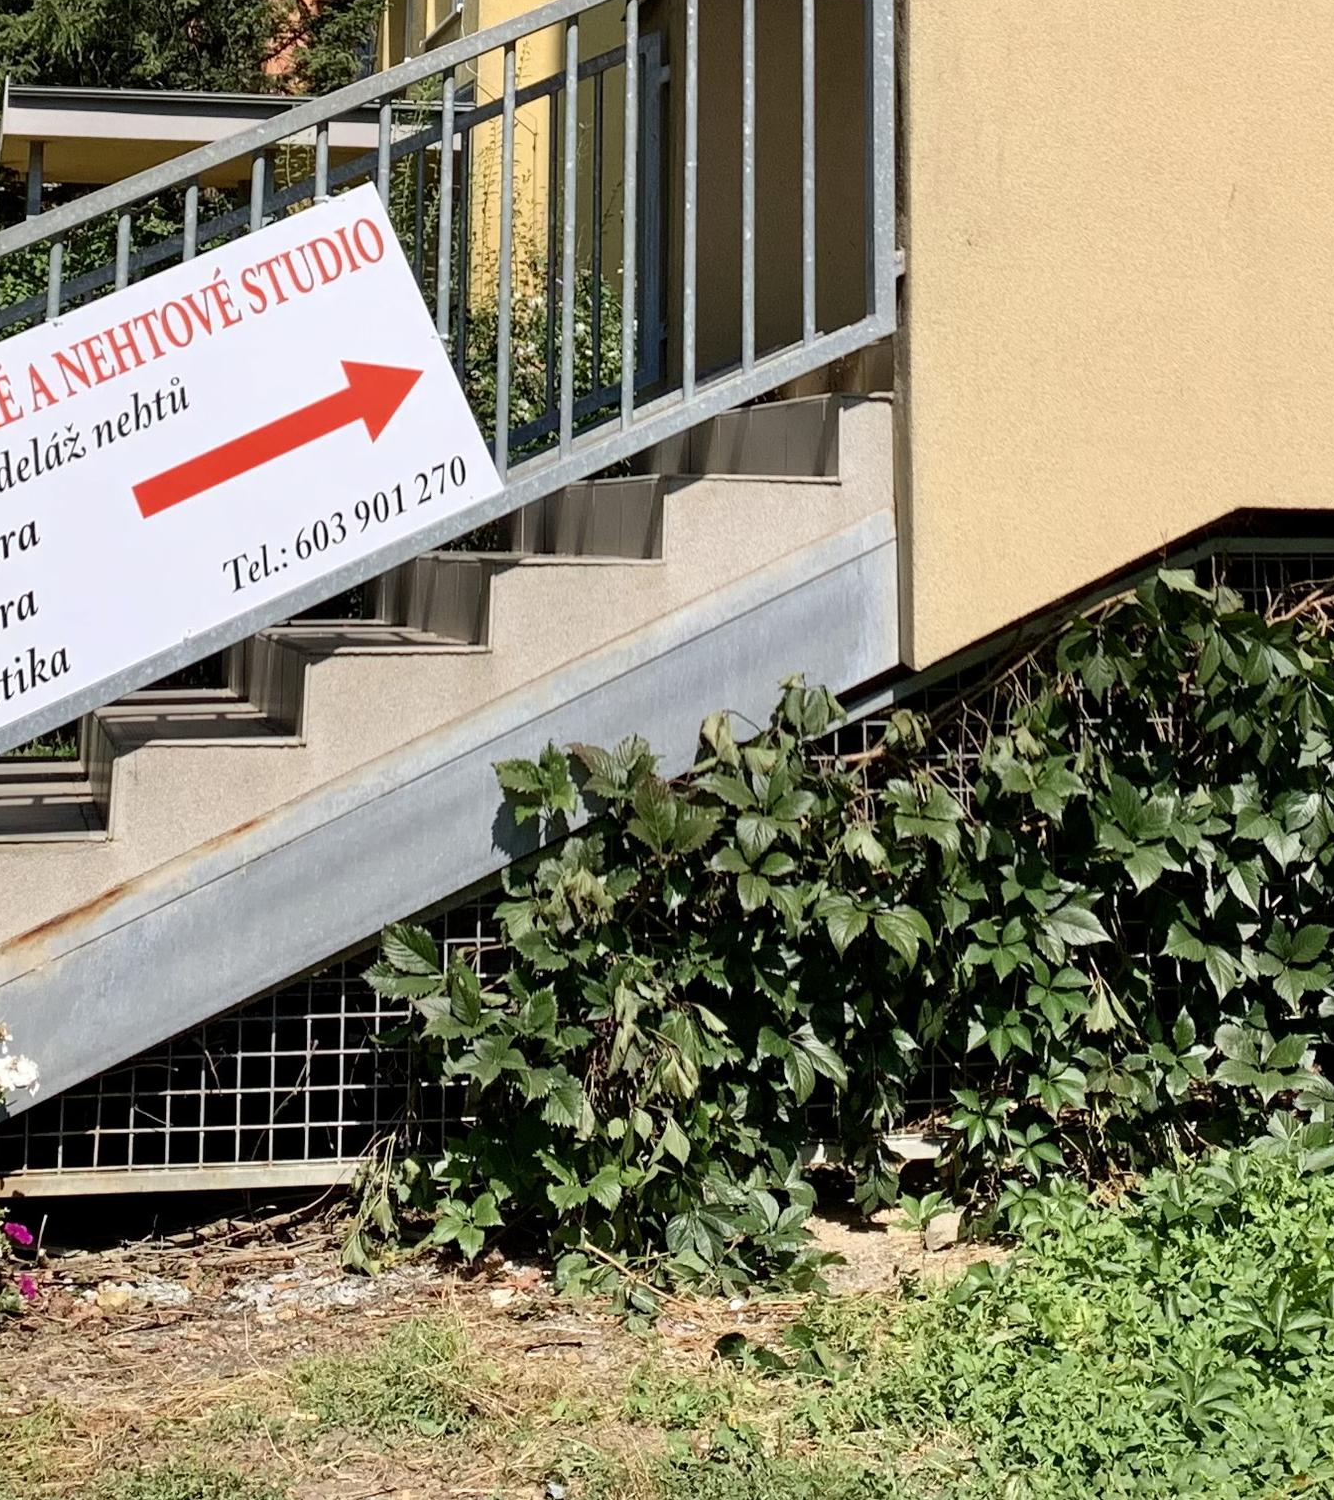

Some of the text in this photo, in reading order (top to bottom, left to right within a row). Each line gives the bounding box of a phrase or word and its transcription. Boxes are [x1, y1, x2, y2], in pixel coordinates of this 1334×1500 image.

[27, 362, 60, 412] A
[50, 267, 243, 397] NEHTOVÉ
[240, 217, 385, 315] STUDIO
[91, 376, 191, 449] nehtů
[222, 455, 467, 593] Tel.: 603 901 270
